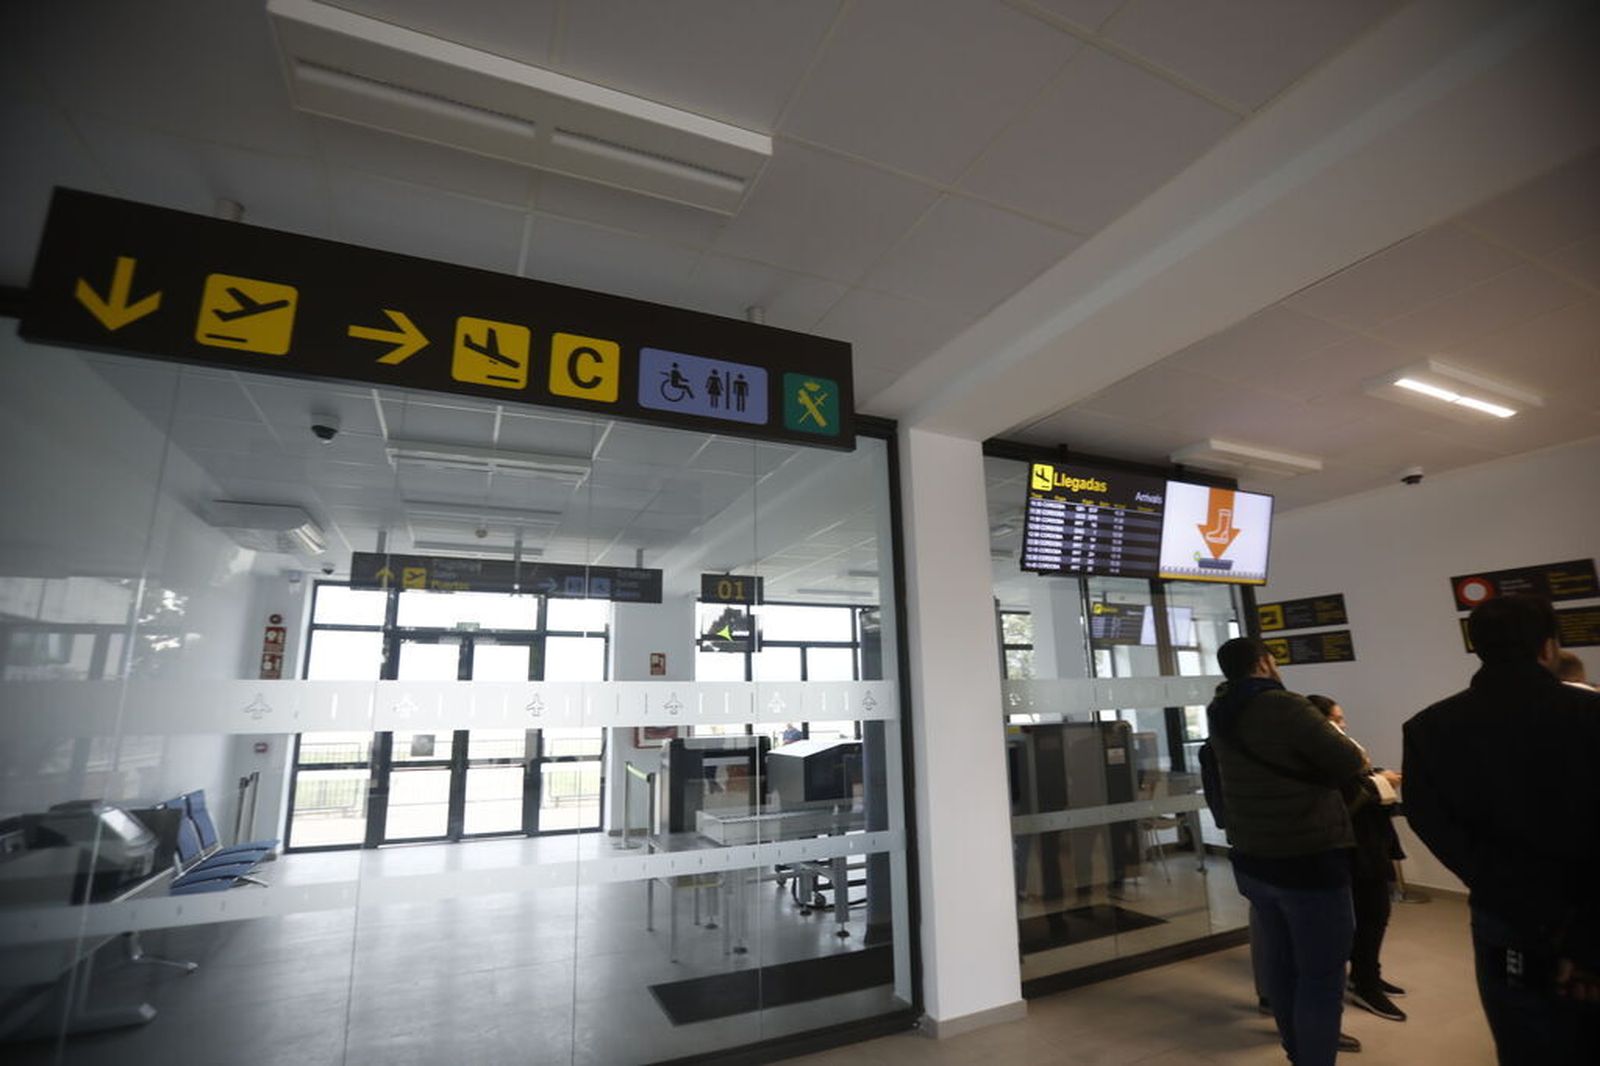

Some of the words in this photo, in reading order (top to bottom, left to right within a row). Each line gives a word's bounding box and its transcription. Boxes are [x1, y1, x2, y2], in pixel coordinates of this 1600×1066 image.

[567, 346, 604, 389] C
[1053, 472, 1107, 493] Llegadas
[718, 580, 745, 600] 01
